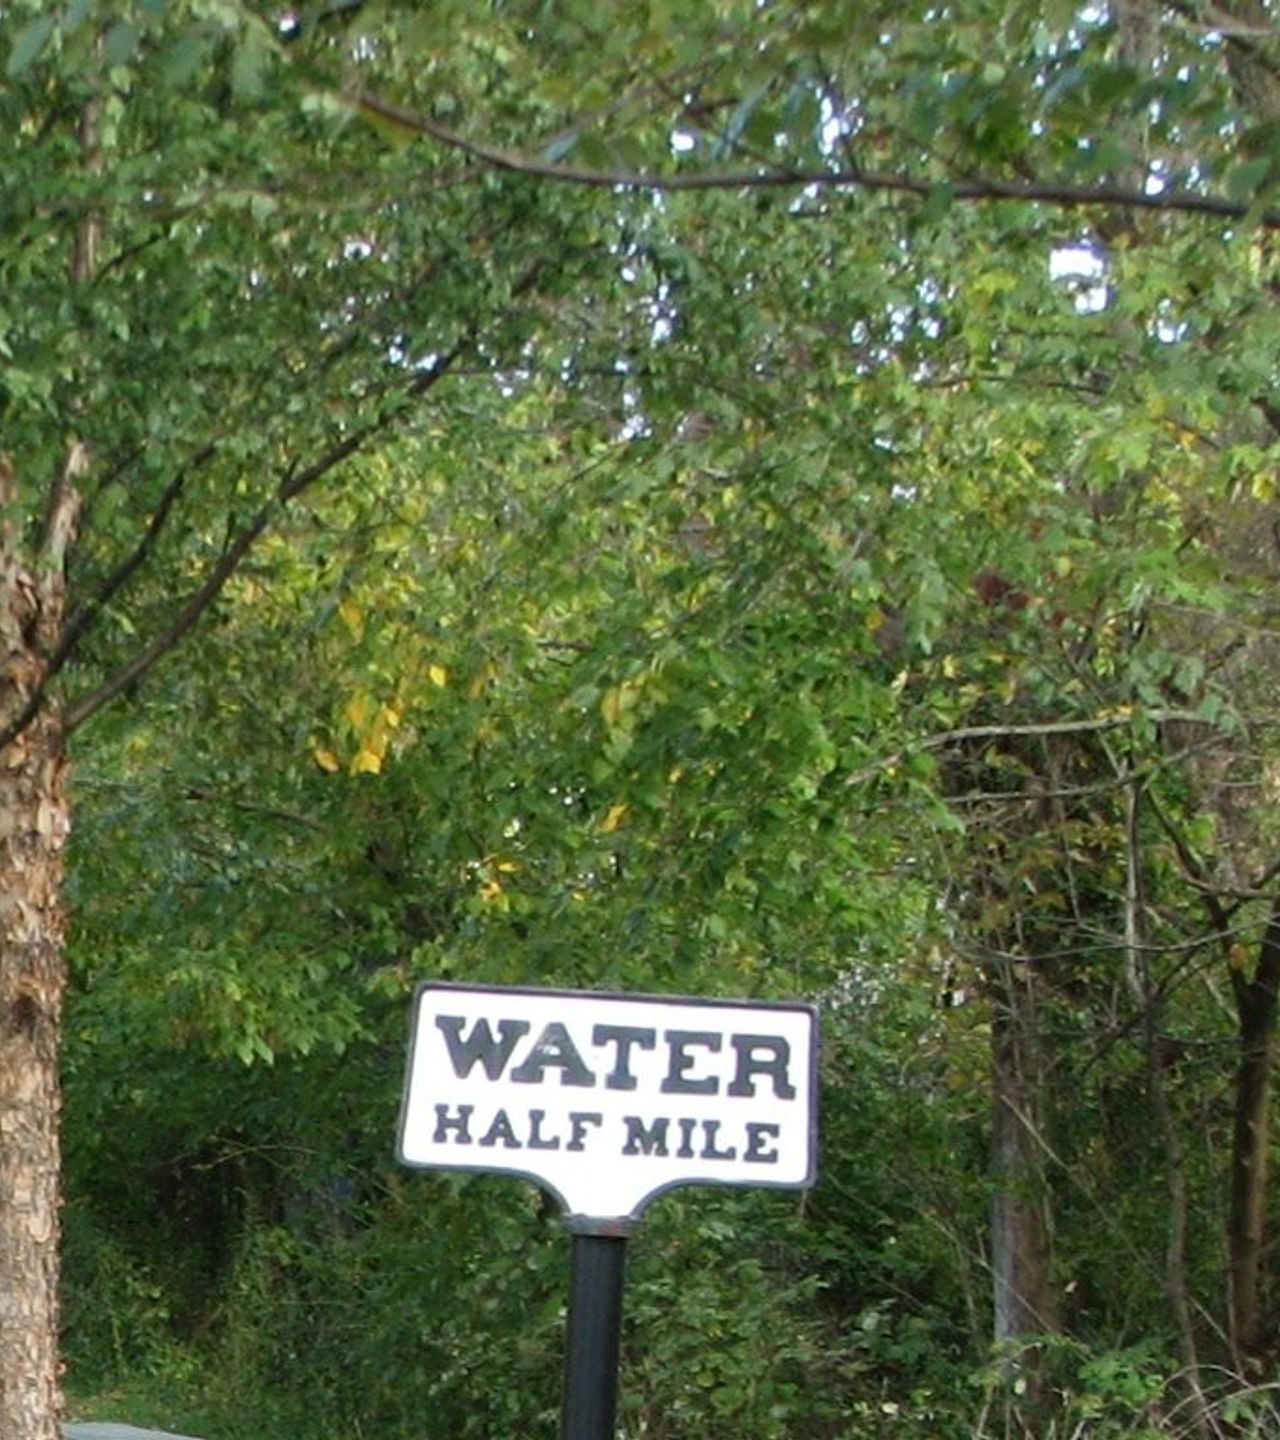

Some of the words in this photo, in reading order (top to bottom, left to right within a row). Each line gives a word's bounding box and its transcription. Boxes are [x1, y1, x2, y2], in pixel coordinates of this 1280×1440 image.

[435, 1015, 796, 1100] WATER
[432, 1103, 603, 1152] HALF
[621, 1116, 780, 1164] MILE
